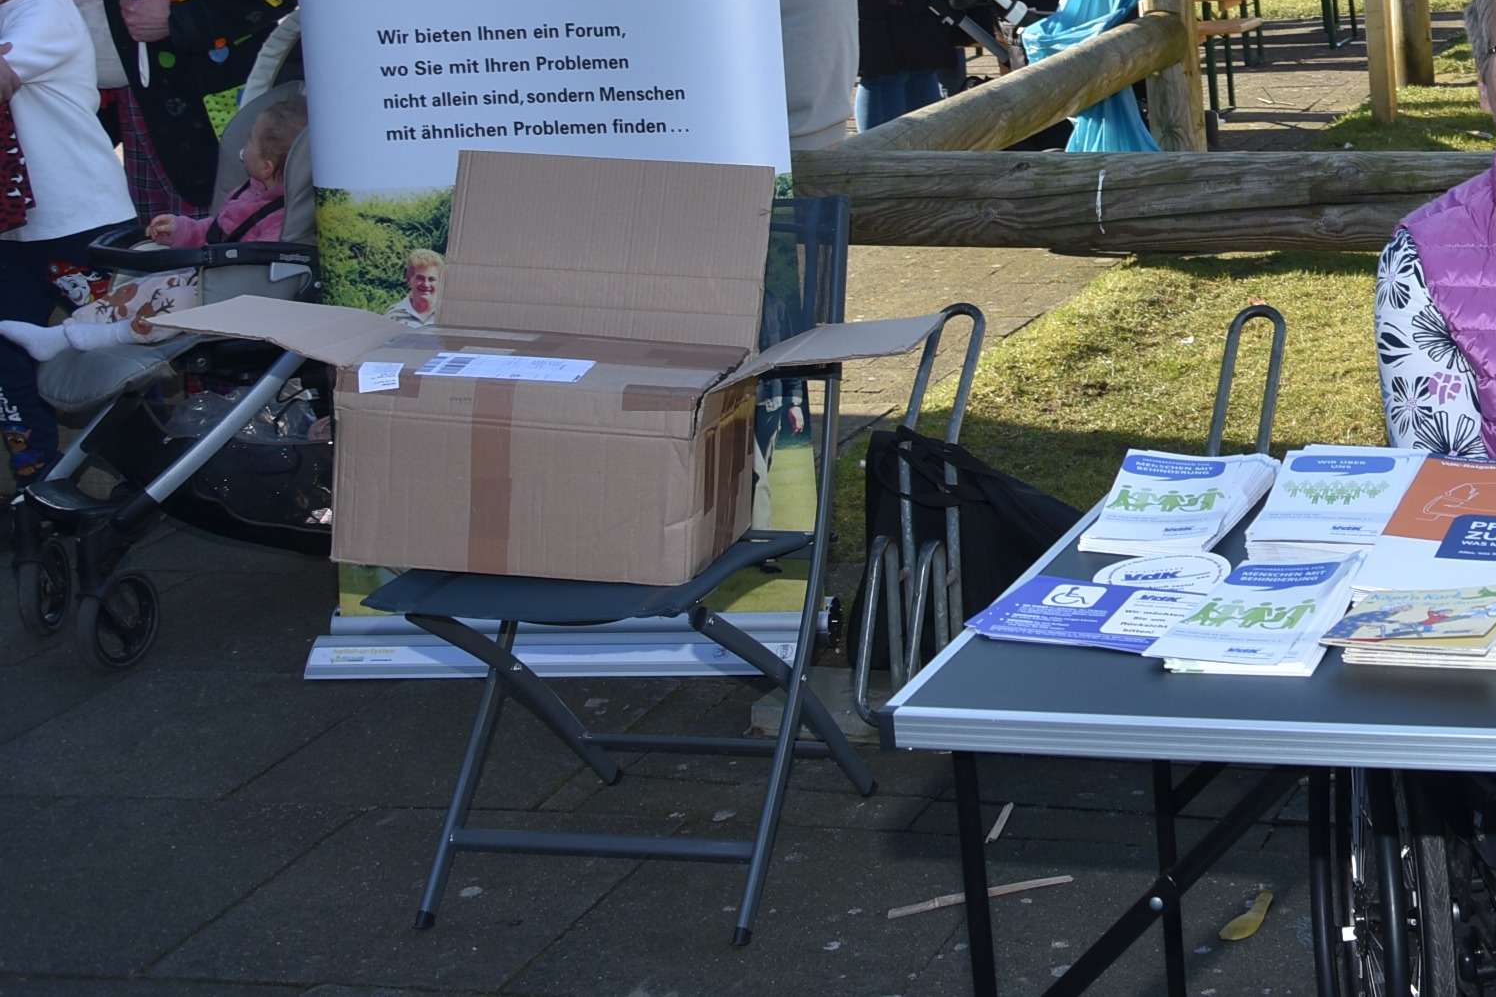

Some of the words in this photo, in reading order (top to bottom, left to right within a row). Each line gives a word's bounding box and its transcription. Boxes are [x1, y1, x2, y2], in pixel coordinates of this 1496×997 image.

[377, 28, 409, 45] Wir
[414, 25, 472, 44] bieten
[477, 24, 528, 42] Ihnen
[532, 22, 560, 40] ein
[564, 22, 627, 42] Forum,
[380, 62, 409, 77] wo
[414, 58, 443, 76] Sie
[448, 57, 480, 75] mit
[484, 56, 531, 74] Ihren
[536, 53, 630, 72] Problemen
[383, 91, 428, 109] nicht
[431, 89, 478, 107] allein
[482, 88, 525, 107] sind,
[526, 86, 596, 104] sondern
[598, 84, 686, 102] Menschen
[385, 124, 417, 142] mit
[420, 122, 508, 140] ähnlichen
[513, 119, 608, 138] Problemen
[1135, 461, 1193, 472] MENSCHEN
[1136, 466, 1210, 476] BEHINDERUNG
[1124, 571, 1182, 581] VdK
[1143, 610, 1185, 618] möchten
